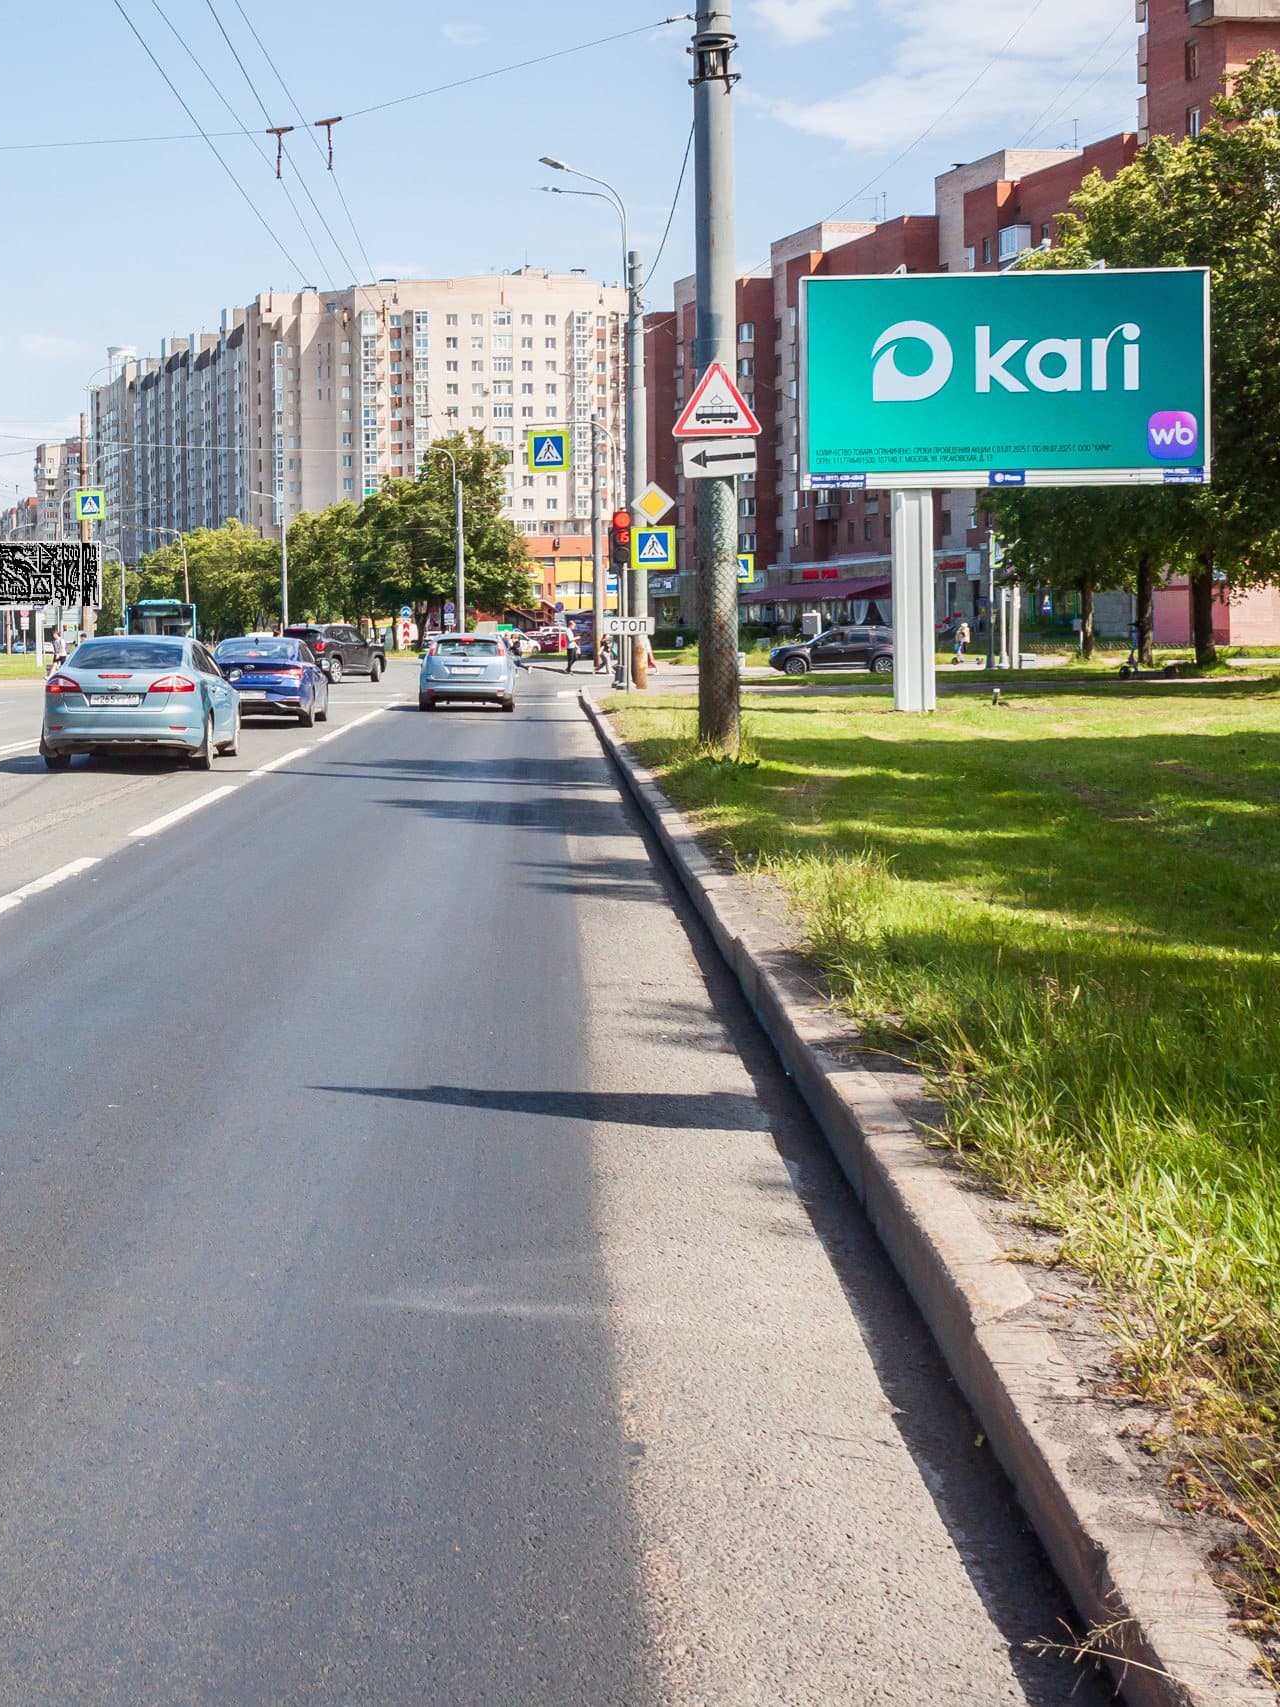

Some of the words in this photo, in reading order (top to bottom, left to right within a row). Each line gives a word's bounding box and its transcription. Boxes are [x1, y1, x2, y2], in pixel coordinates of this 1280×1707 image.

[975, 322, 1141, 393] kari
[1150, 420, 1194, 446] wb
[610, 620, 647, 632] СТОП
